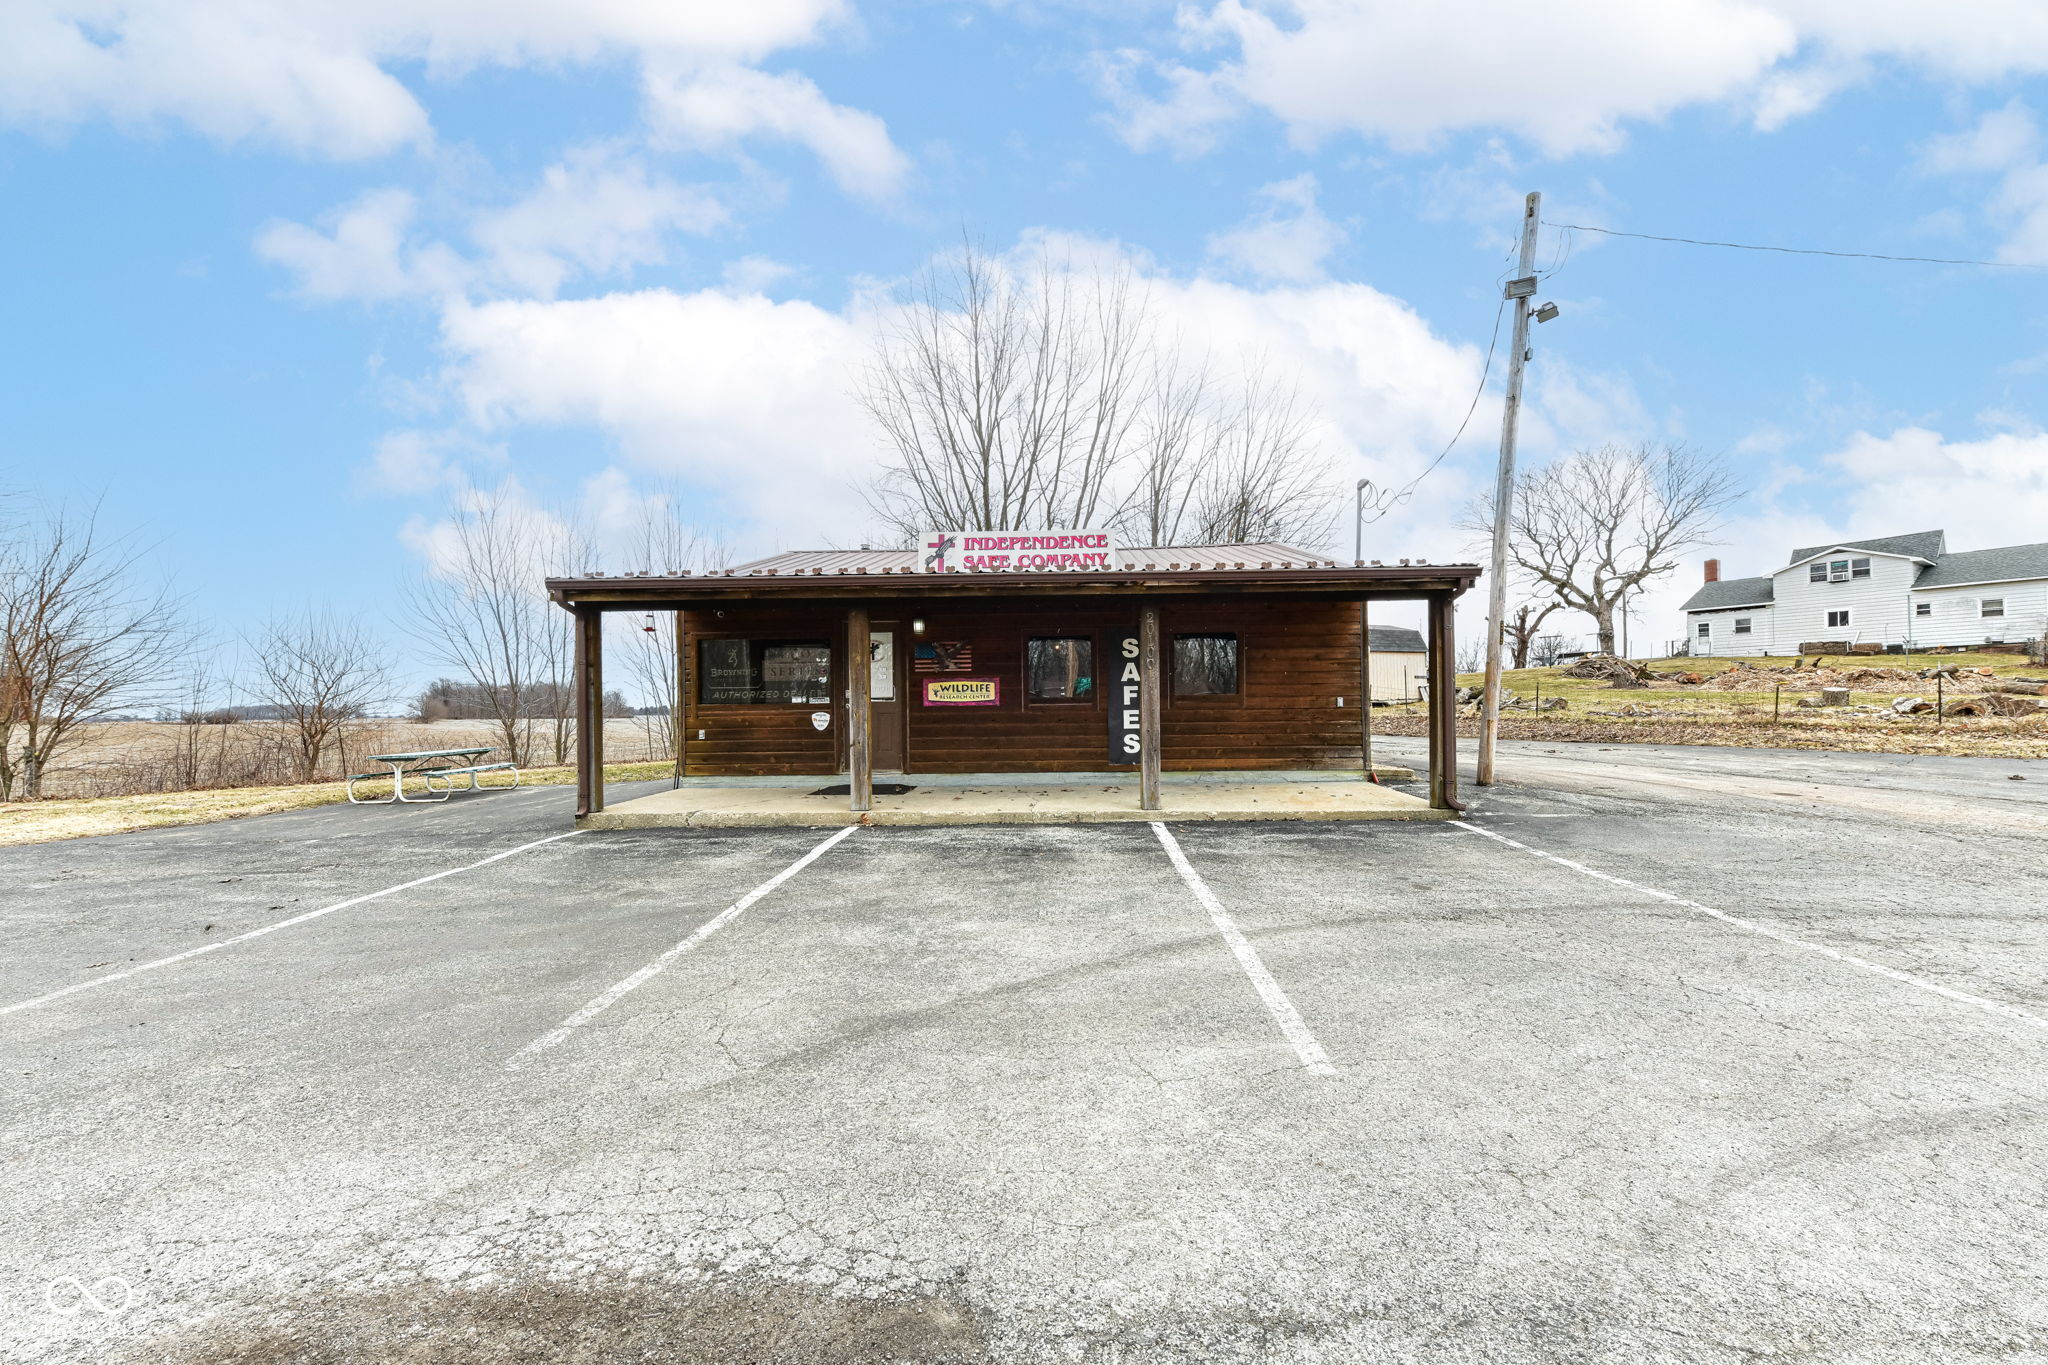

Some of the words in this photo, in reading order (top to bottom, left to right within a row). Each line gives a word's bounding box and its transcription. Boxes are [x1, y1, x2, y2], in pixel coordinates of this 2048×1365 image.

[963, 534, 1109, 551] INDEPENDENCE
[963, 554, 1010, 569] SAFE
[1017, 552, 1109, 569] COMPANY
[712, 690, 780, 699] AUTHORIZED
[940, 683, 991, 693] WILDLIFE
[1121, 638, 1141, 754] SAFES
